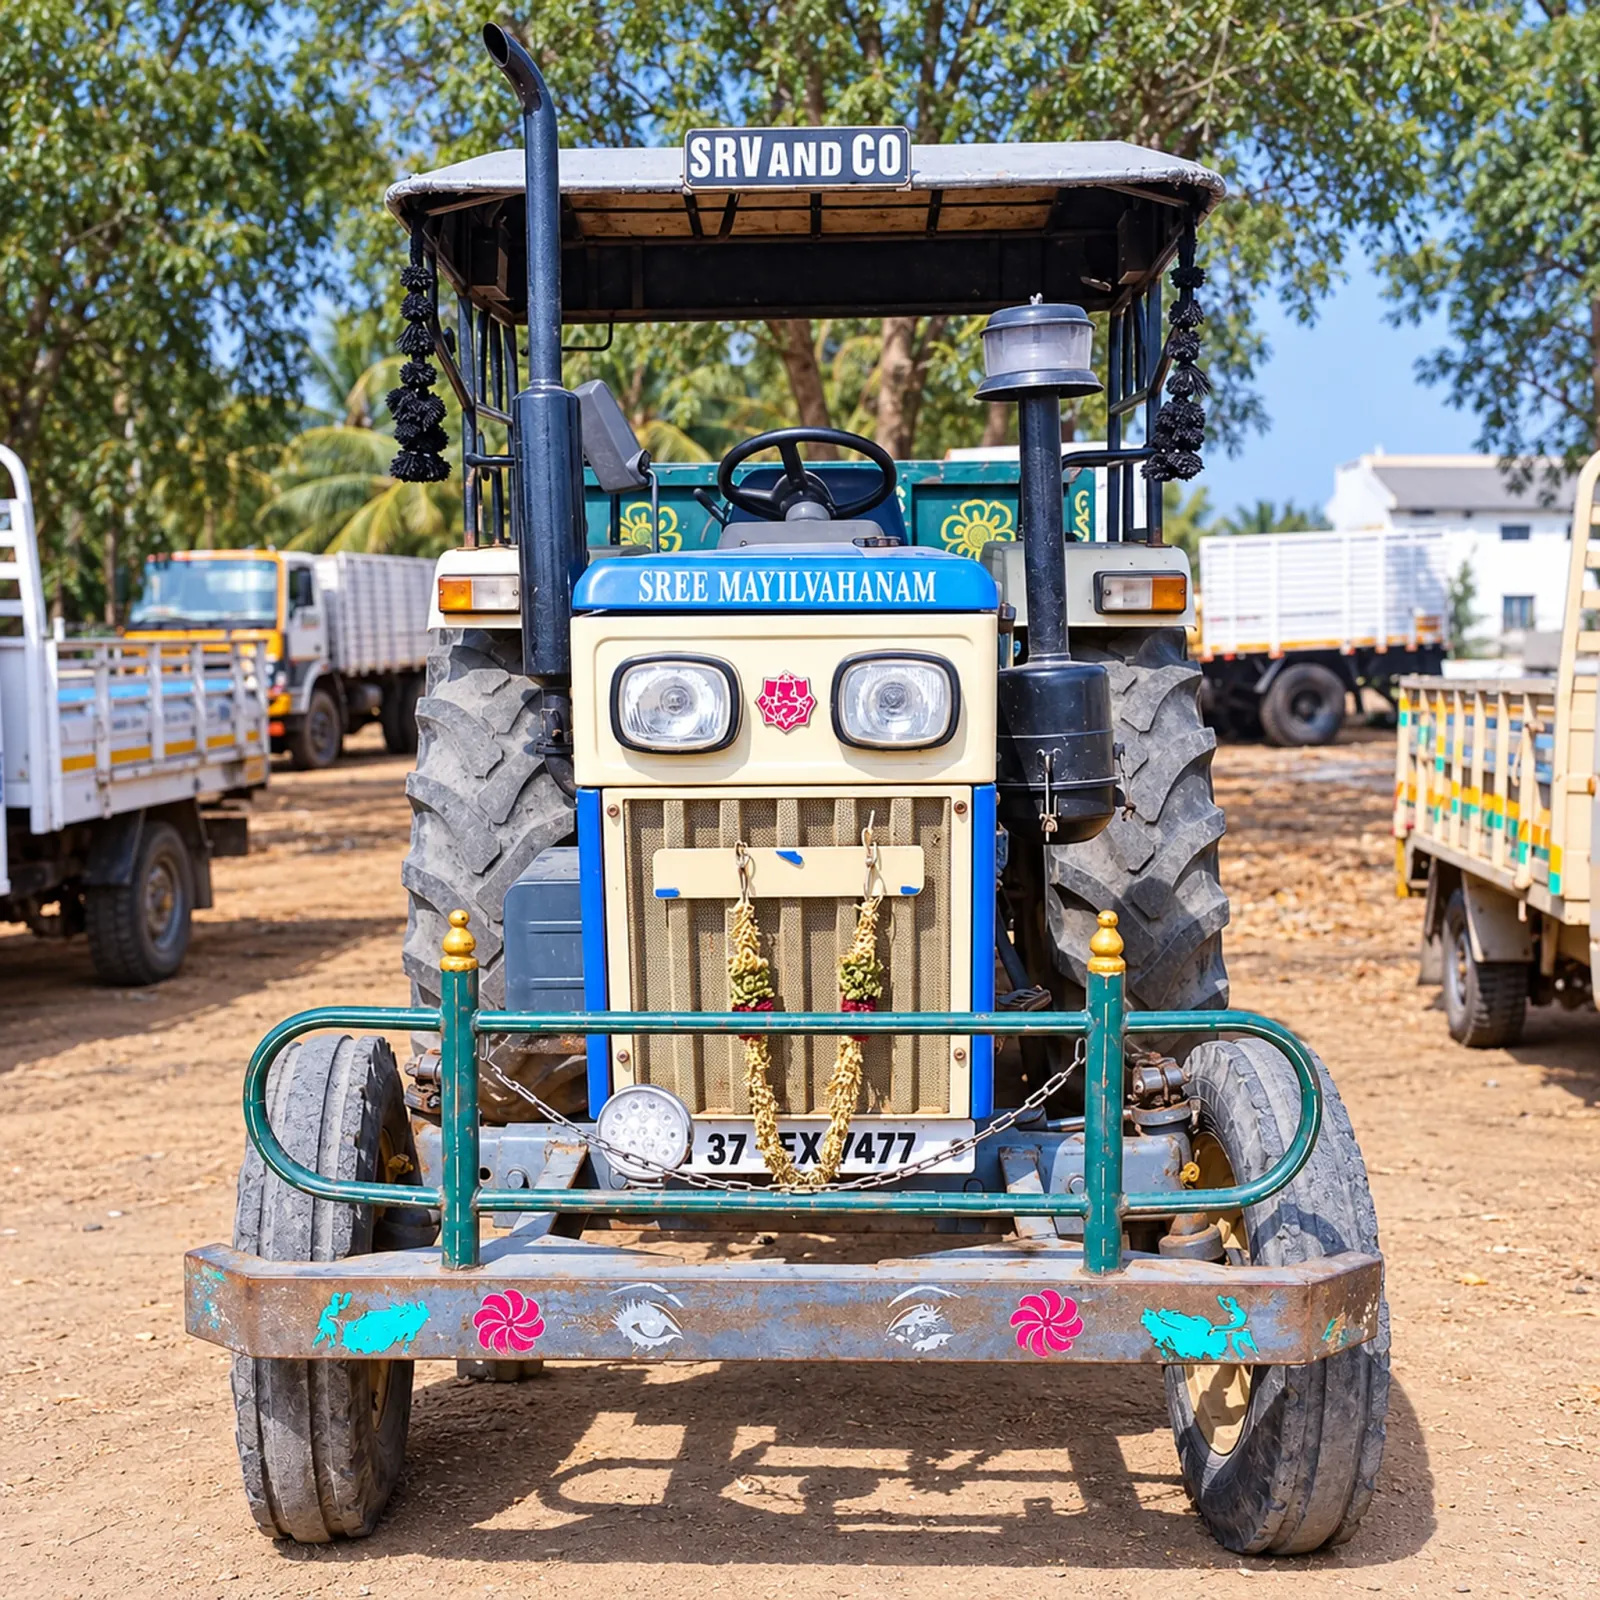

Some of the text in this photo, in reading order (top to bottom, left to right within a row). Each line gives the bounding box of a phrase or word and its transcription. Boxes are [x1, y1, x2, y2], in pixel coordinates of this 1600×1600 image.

[690, 133, 901, 178] SRV AND CO
[638, 569, 937, 603] SREE MAYILVAHANAM
[707, 1133, 747, 1165] 37
